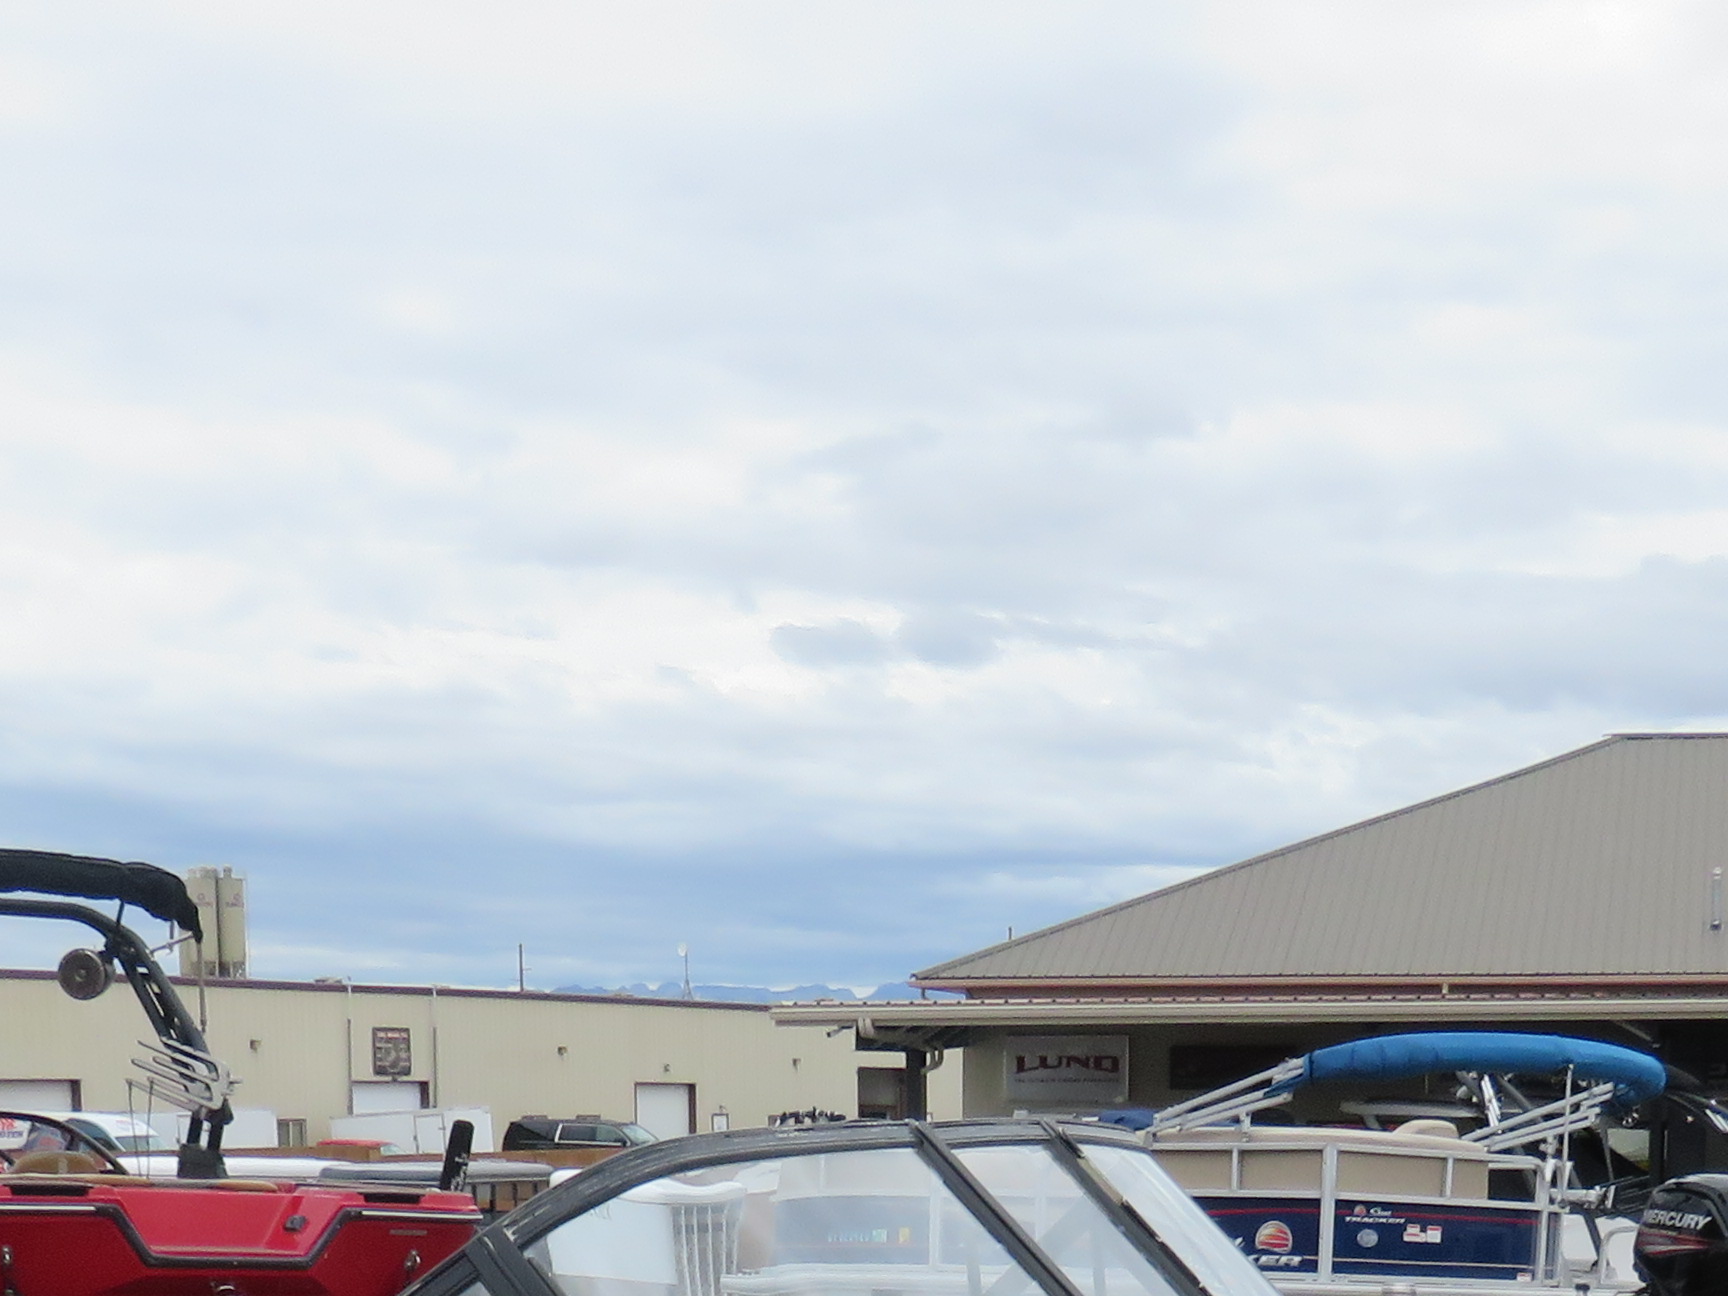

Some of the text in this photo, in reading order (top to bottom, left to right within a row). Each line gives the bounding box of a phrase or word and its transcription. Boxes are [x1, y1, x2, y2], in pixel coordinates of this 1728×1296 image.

[1015, 1055, 1120, 1074] LUND
[1344, 1216, 1406, 1225] TRACKER
[1644, 1209, 1712, 1230] MERCURY
